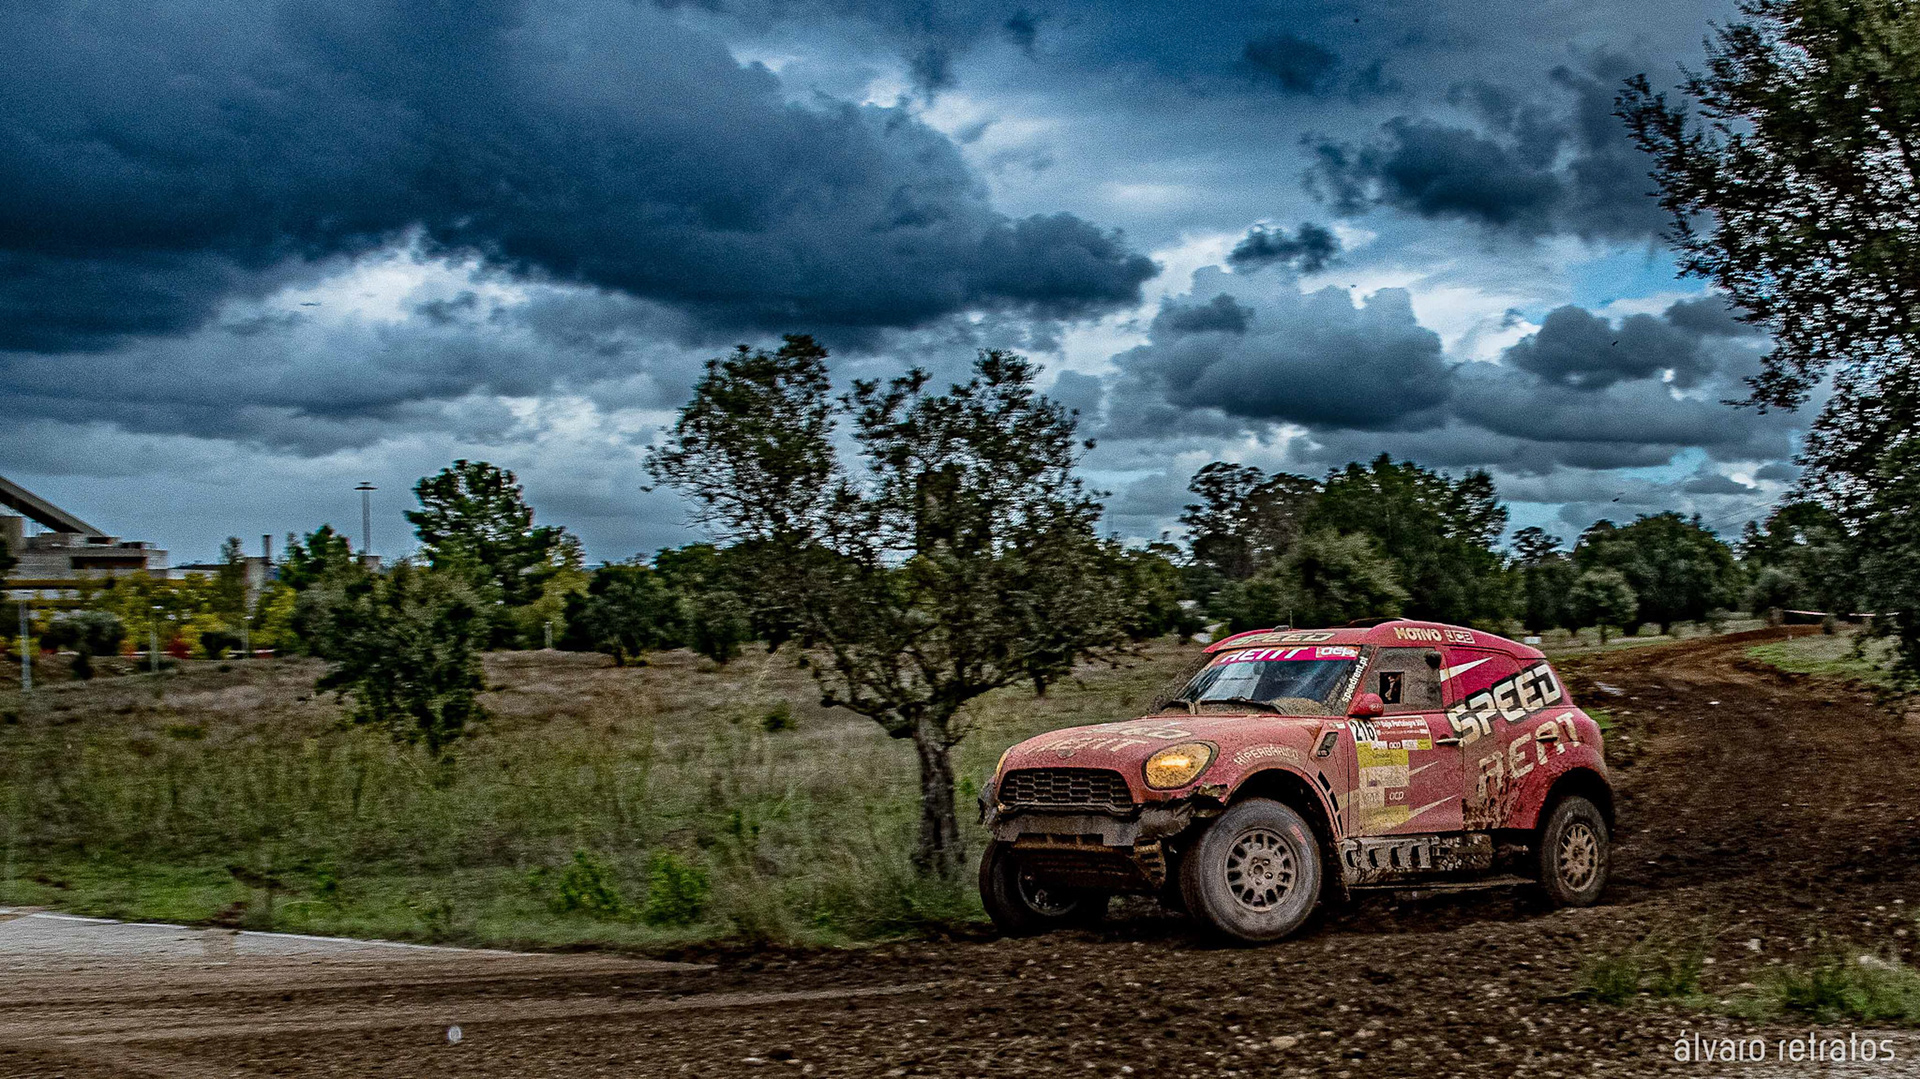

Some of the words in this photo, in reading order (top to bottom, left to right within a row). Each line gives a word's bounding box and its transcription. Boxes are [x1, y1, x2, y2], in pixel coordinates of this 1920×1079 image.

[1226, 632, 1336, 647] SPEED
[1393, 627, 1442, 641] MOTIVO
[1341, 656, 1369, 703] speedrent.pt
[1446, 663, 1562, 747] SPEED
[1350, 720, 1376, 741] 216
[1477, 711, 1580, 798] RENT
